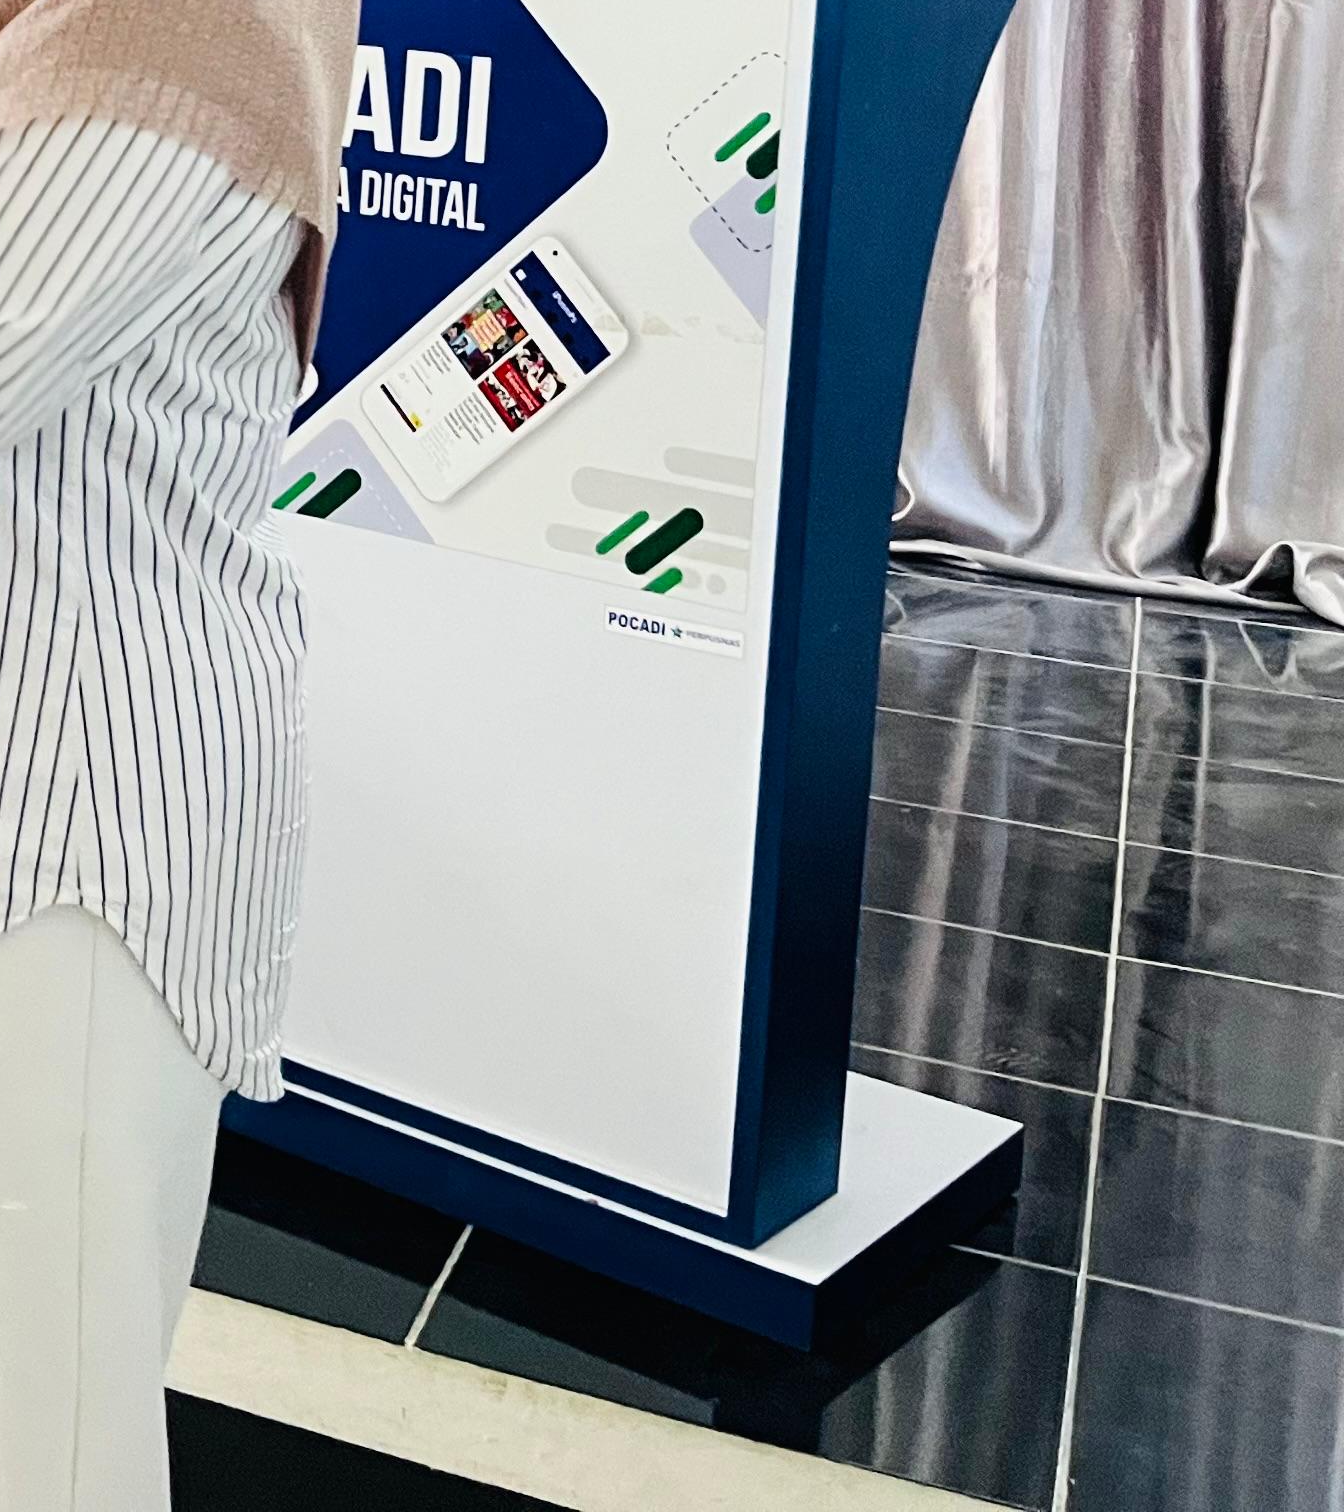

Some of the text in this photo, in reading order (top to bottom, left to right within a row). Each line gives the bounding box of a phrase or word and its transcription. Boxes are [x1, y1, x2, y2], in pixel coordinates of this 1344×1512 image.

[341, 44, 492, 164] ADI
[359, 169, 486, 232] DIGITAL
[608, 611, 666, 636] POCADI
